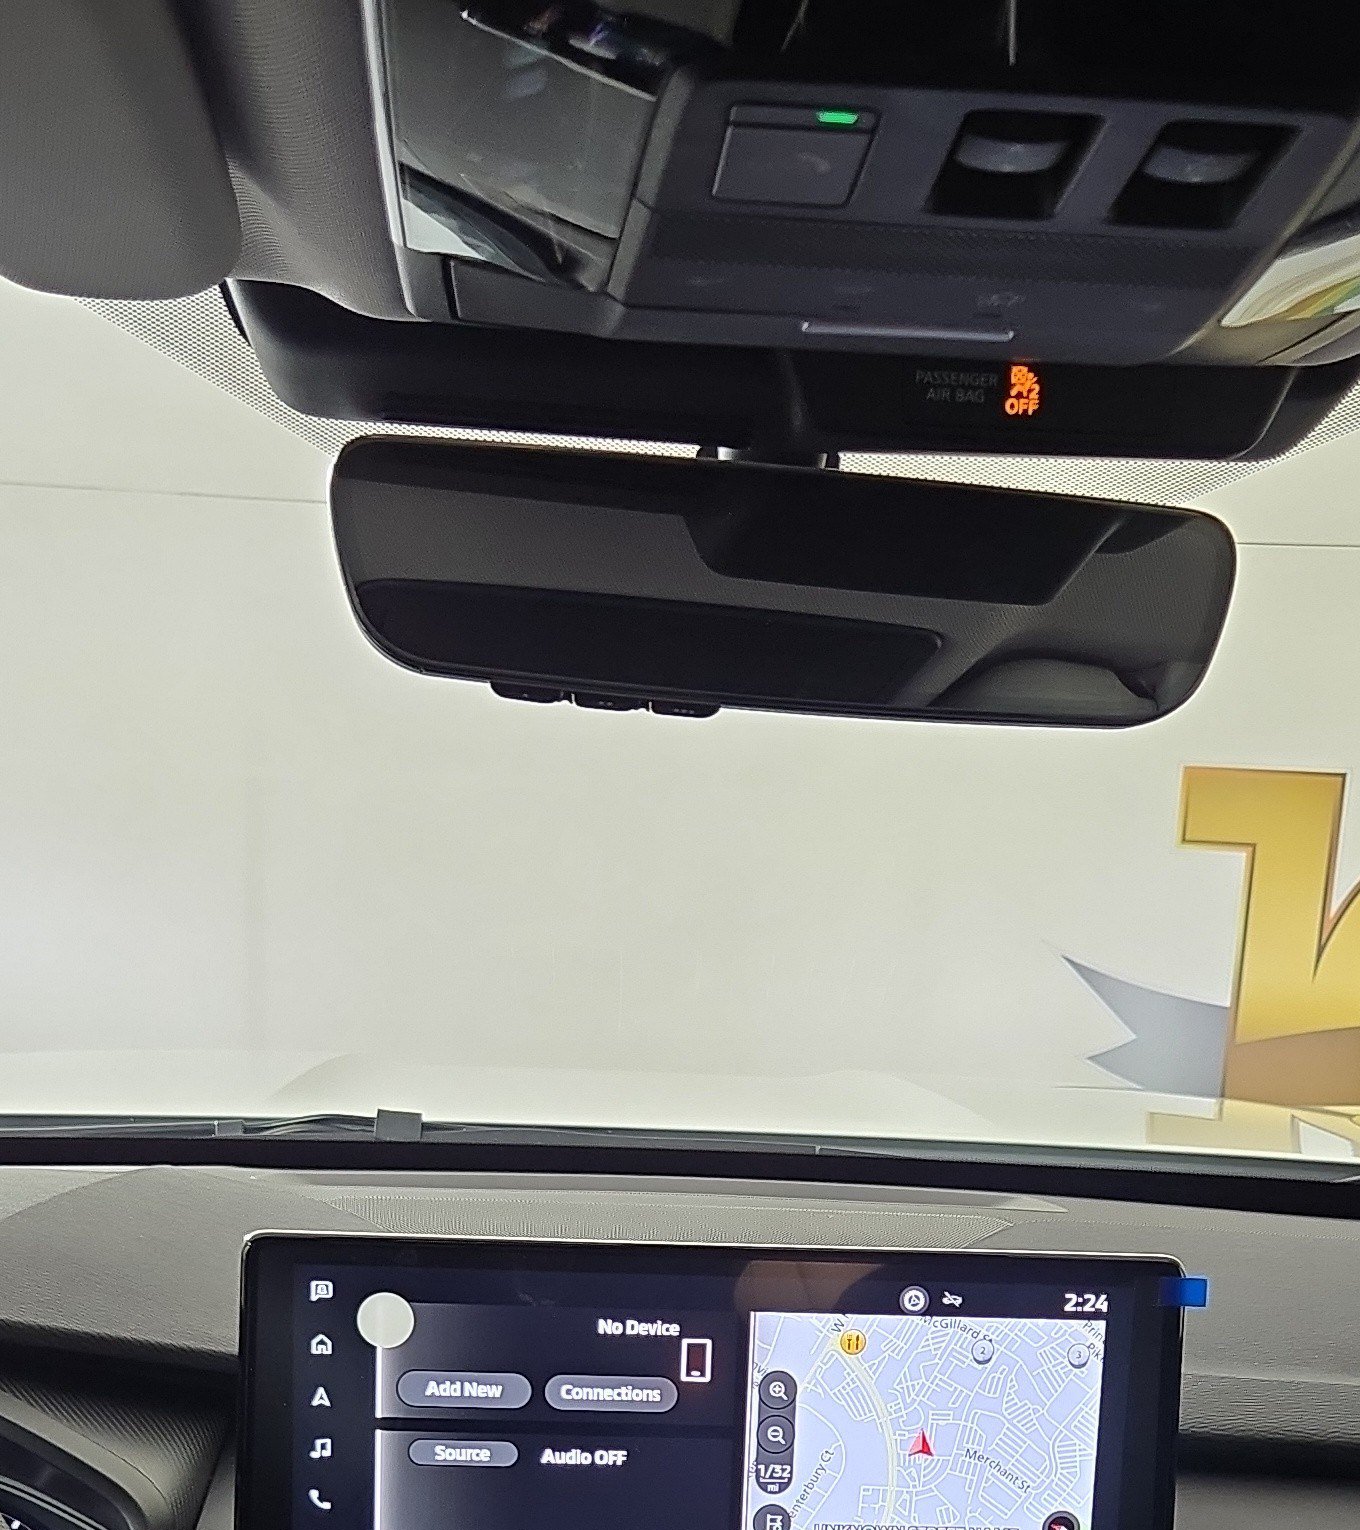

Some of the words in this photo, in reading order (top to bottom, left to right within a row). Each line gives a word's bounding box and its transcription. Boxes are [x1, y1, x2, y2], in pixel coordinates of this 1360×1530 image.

[915, 370, 998, 386] PASSENGER
[926, 387, 951, 401] AIR
[1004, 398, 1040, 416] OFF
[1063, 1293, 1109, 1313] 2:24
[597, 1318, 622, 1335] No
[625, 1319, 681, 1337] Device
[425, 1381, 461, 1398] Add
[464, 1381, 503, 1398] New
[560, 1384, 662, 1402] Connections
[434, 1446, 491, 1462] Source
[540, 1448, 592, 1466] Audio
[594, 1449, 628, 1467] OFF
[757, 1464, 792, 1479] 1/32
[965, 1448, 1018, 1485] Merchant
[1017, 1480, 1031, 1493] St
[767, 1483, 780, 1493] mi
[790, 1463, 827, 1522] enterbury
[820, 1449, 835, 1463] Ct
